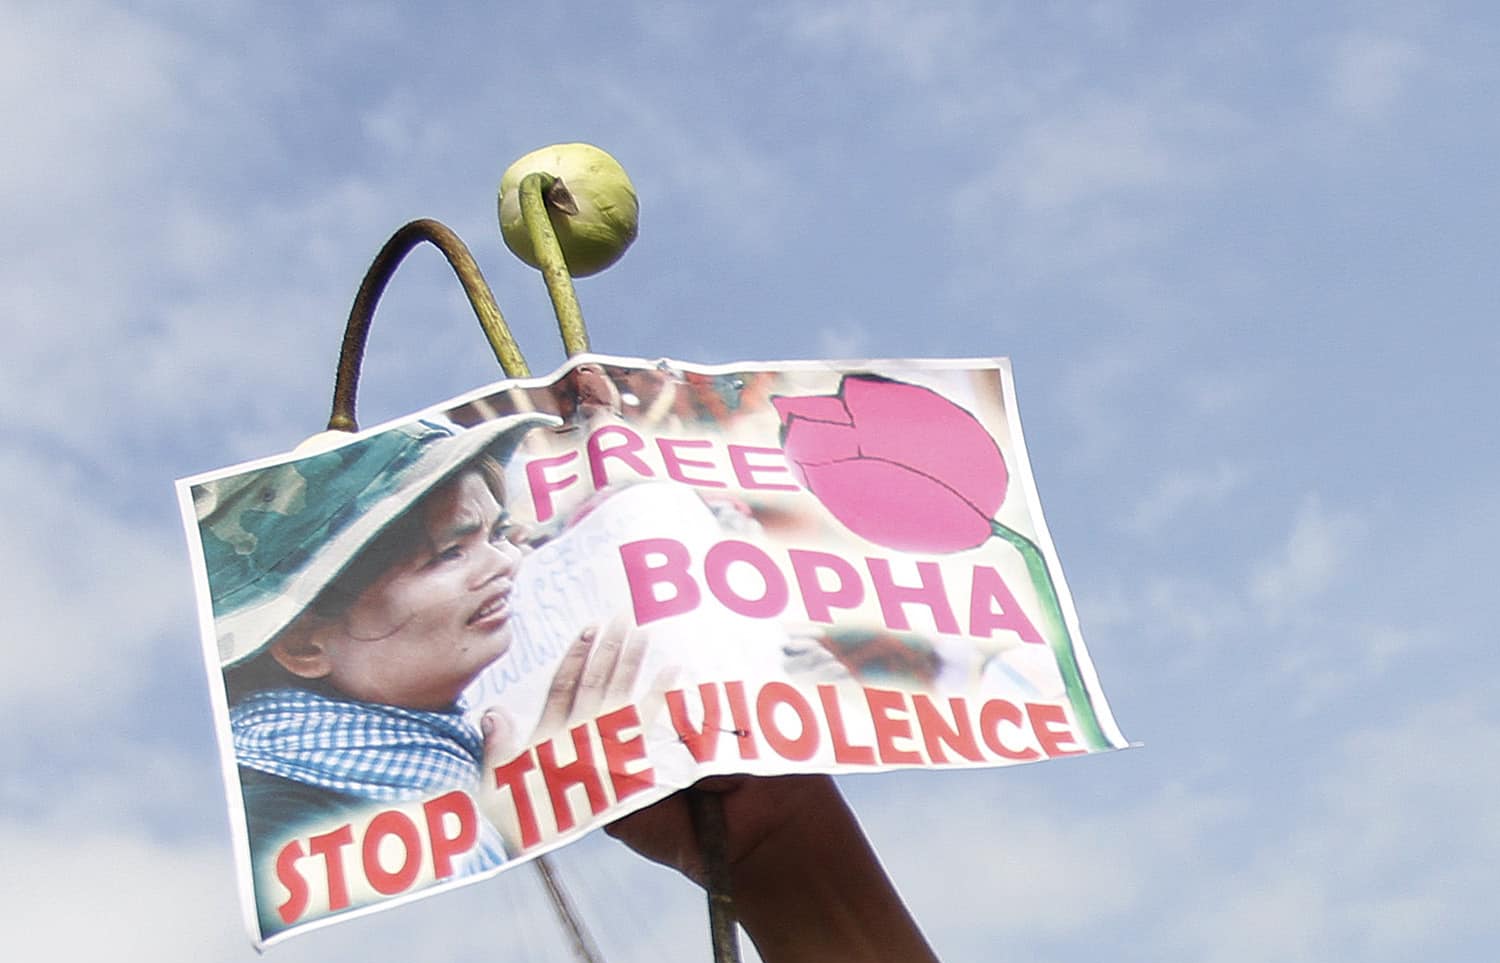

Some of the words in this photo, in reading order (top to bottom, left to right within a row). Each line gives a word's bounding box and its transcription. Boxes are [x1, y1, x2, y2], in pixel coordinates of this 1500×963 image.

[525, 424, 802, 523] FREE
[621, 538, 1044, 644] BOPHA
[275, 790, 478, 925] STOP
[494, 704, 656, 849] THE
[664, 681, 1087, 766] VIOLENCE
